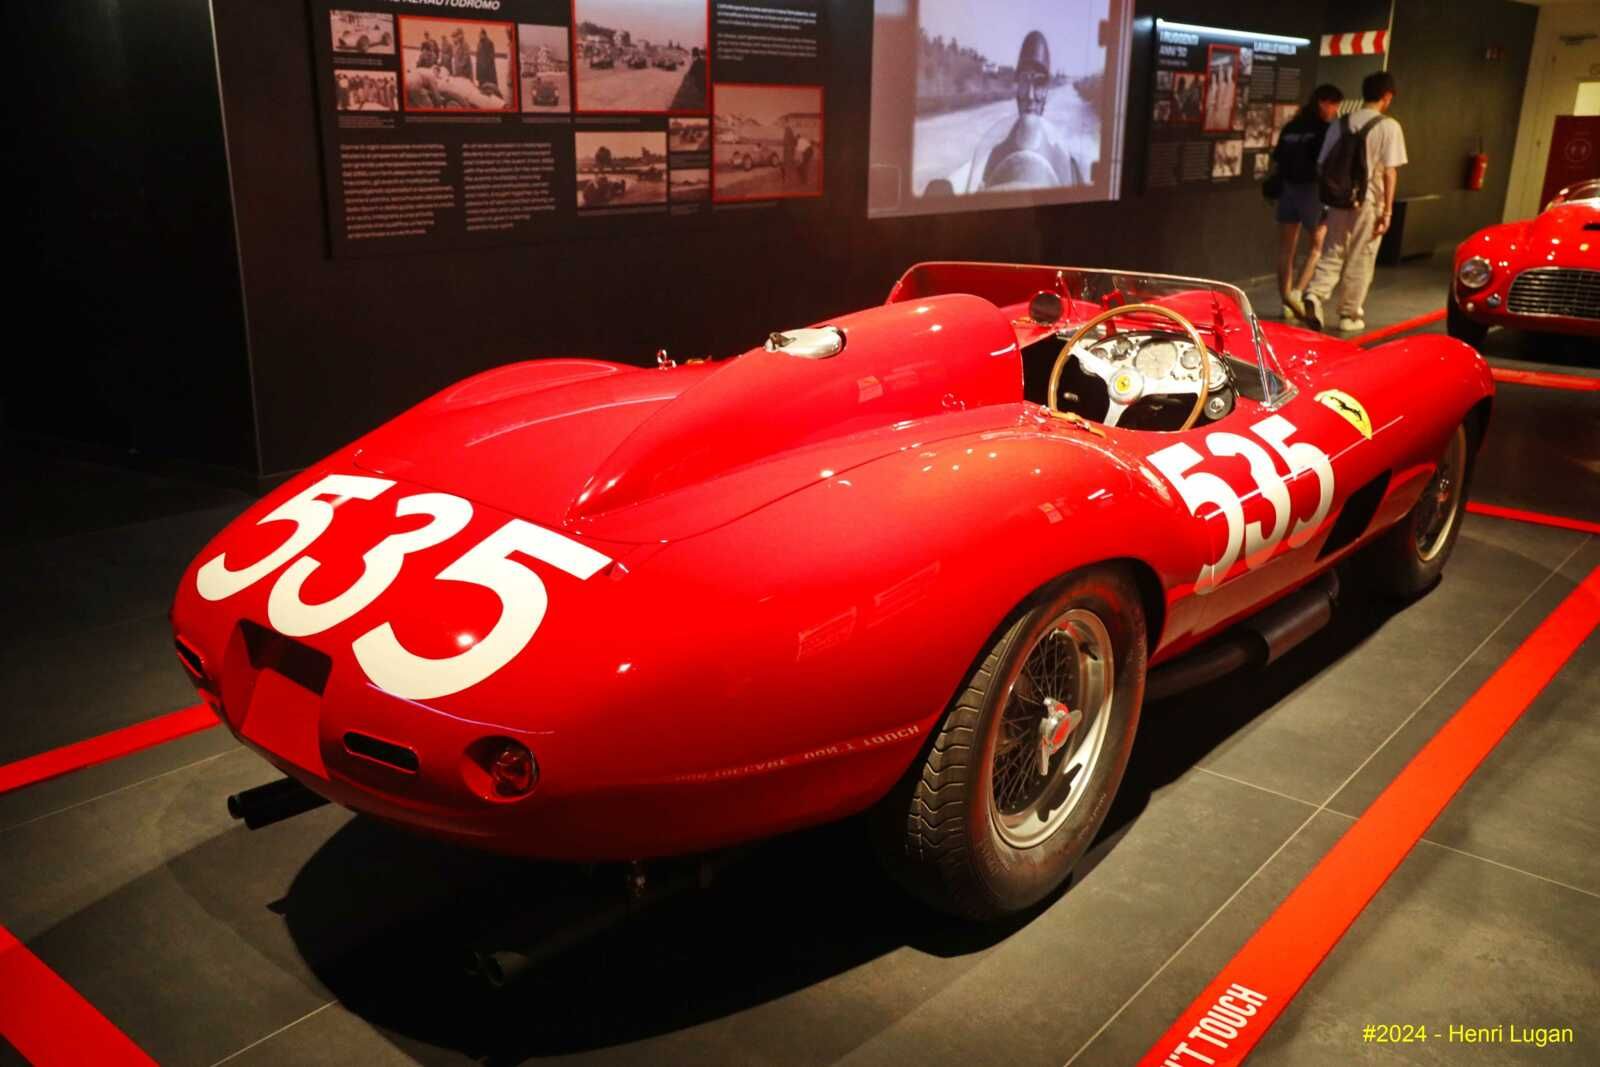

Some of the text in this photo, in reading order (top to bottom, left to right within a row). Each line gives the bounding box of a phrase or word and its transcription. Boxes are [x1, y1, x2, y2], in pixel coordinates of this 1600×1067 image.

[196, 474, 612, 700] 535
[1146, 414, 1335, 595] 535
[1188, 982, 1268, 1049] TOUCH
